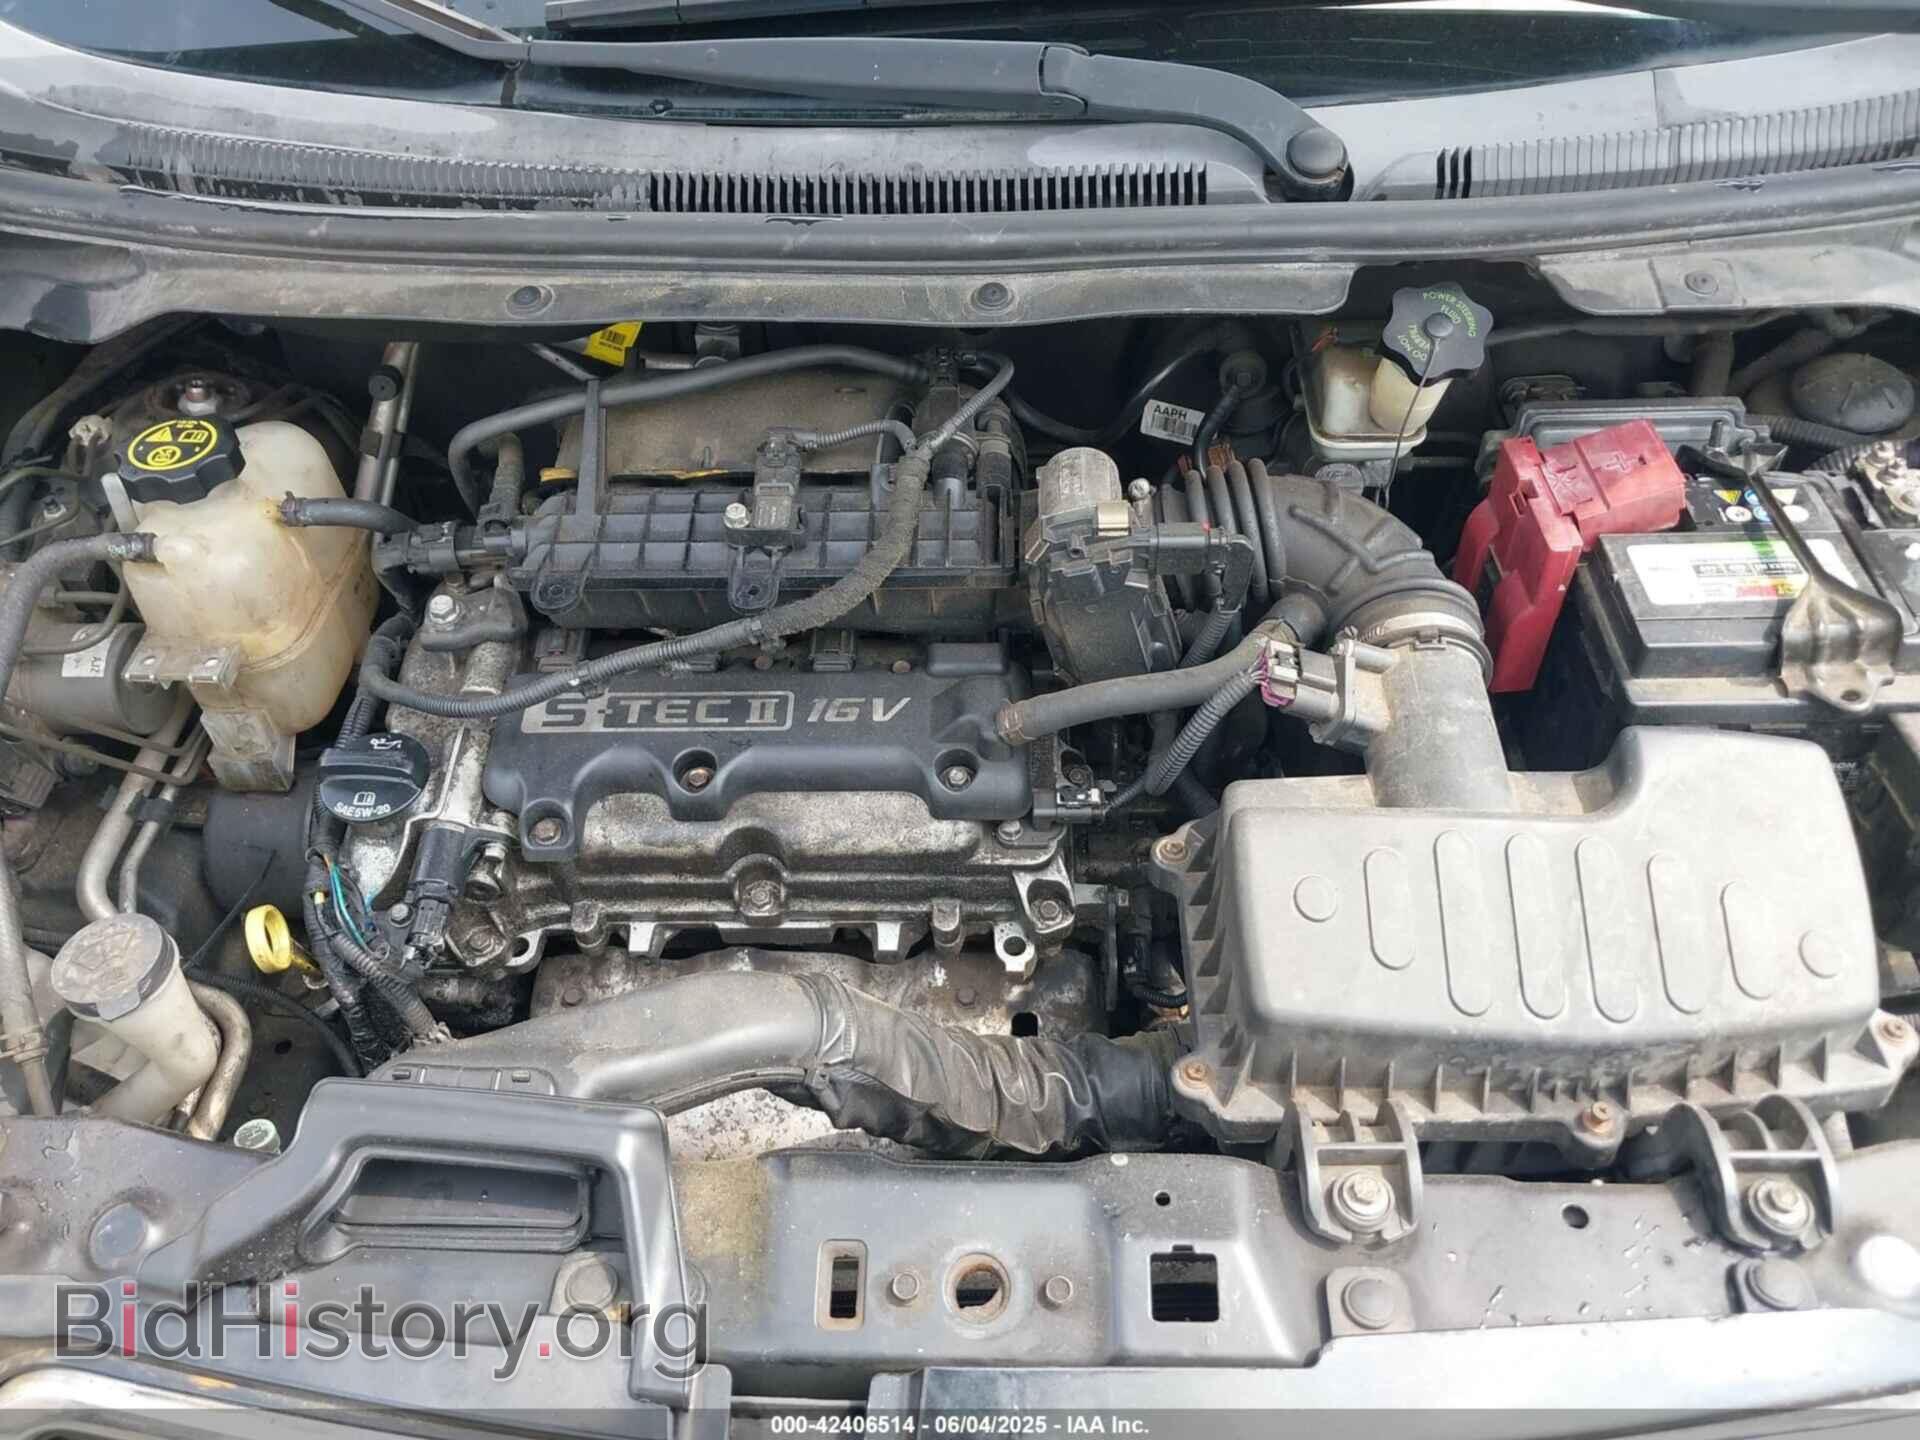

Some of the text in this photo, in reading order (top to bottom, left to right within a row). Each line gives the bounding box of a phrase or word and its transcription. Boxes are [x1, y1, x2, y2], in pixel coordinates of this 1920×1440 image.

[1423, 291, 1477, 337] POWER STEERING
[1440, 304, 1460, 325] FLUID
[1397, 335, 1428, 361] DO NOT
[1153, 405, 1187, 417] AAPH
[807, 697, 911, 723] 16V
[334, 802, 391, 818] SAE 5W-20
